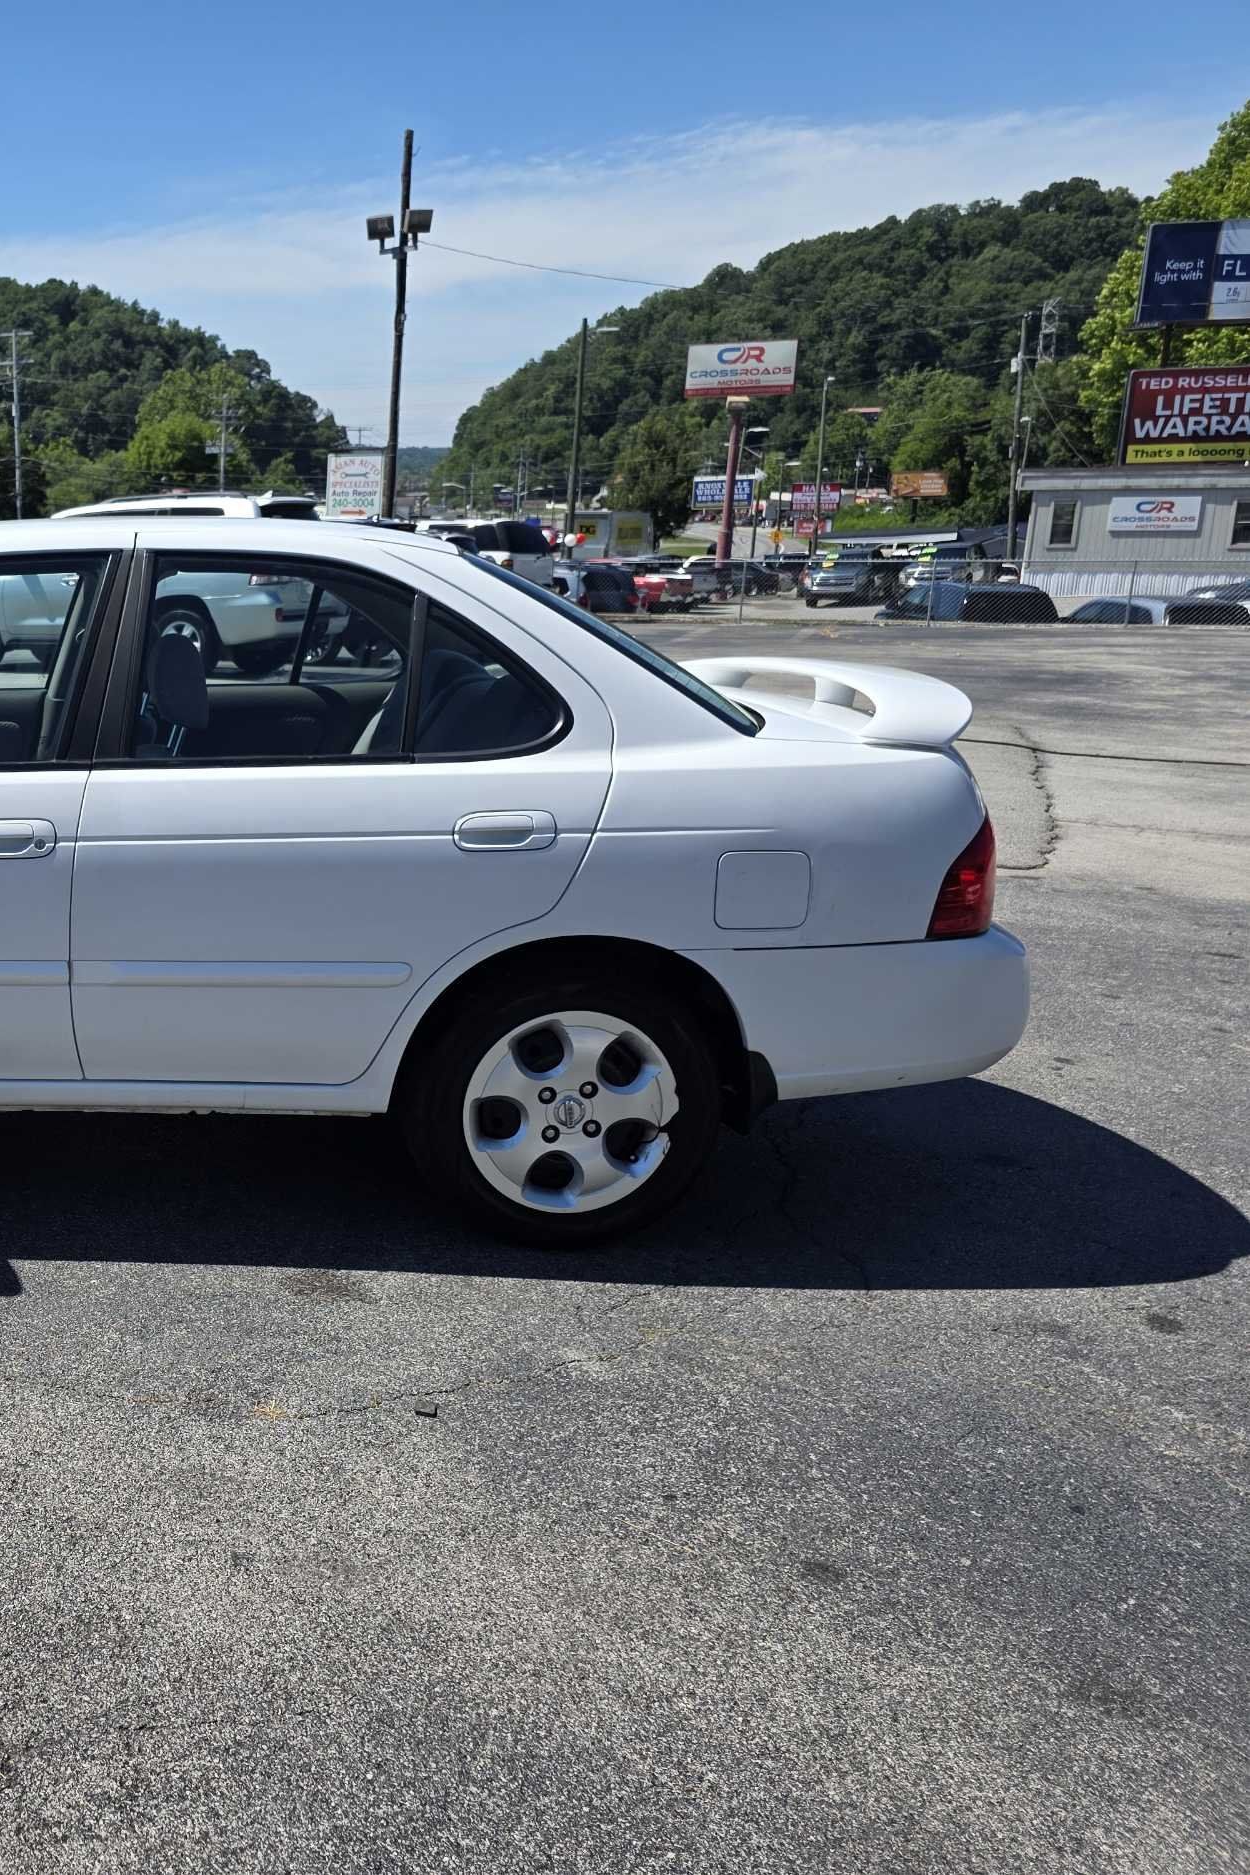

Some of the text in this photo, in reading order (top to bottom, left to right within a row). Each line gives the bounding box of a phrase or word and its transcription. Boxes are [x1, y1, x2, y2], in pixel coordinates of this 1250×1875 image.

[1166, 258, 1205, 271] Keep it
[1154, 270, 1203, 284] light with
[690, 366, 792, 379] CROSSROADS
[1139, 377, 1173, 390] TED
[1134, 415, 1250, 439] WARRA
[1133, 448, 1173, 458] That's
[1189, 448, 1245, 458] loooong
[802, 484, 830, 493] HALS
